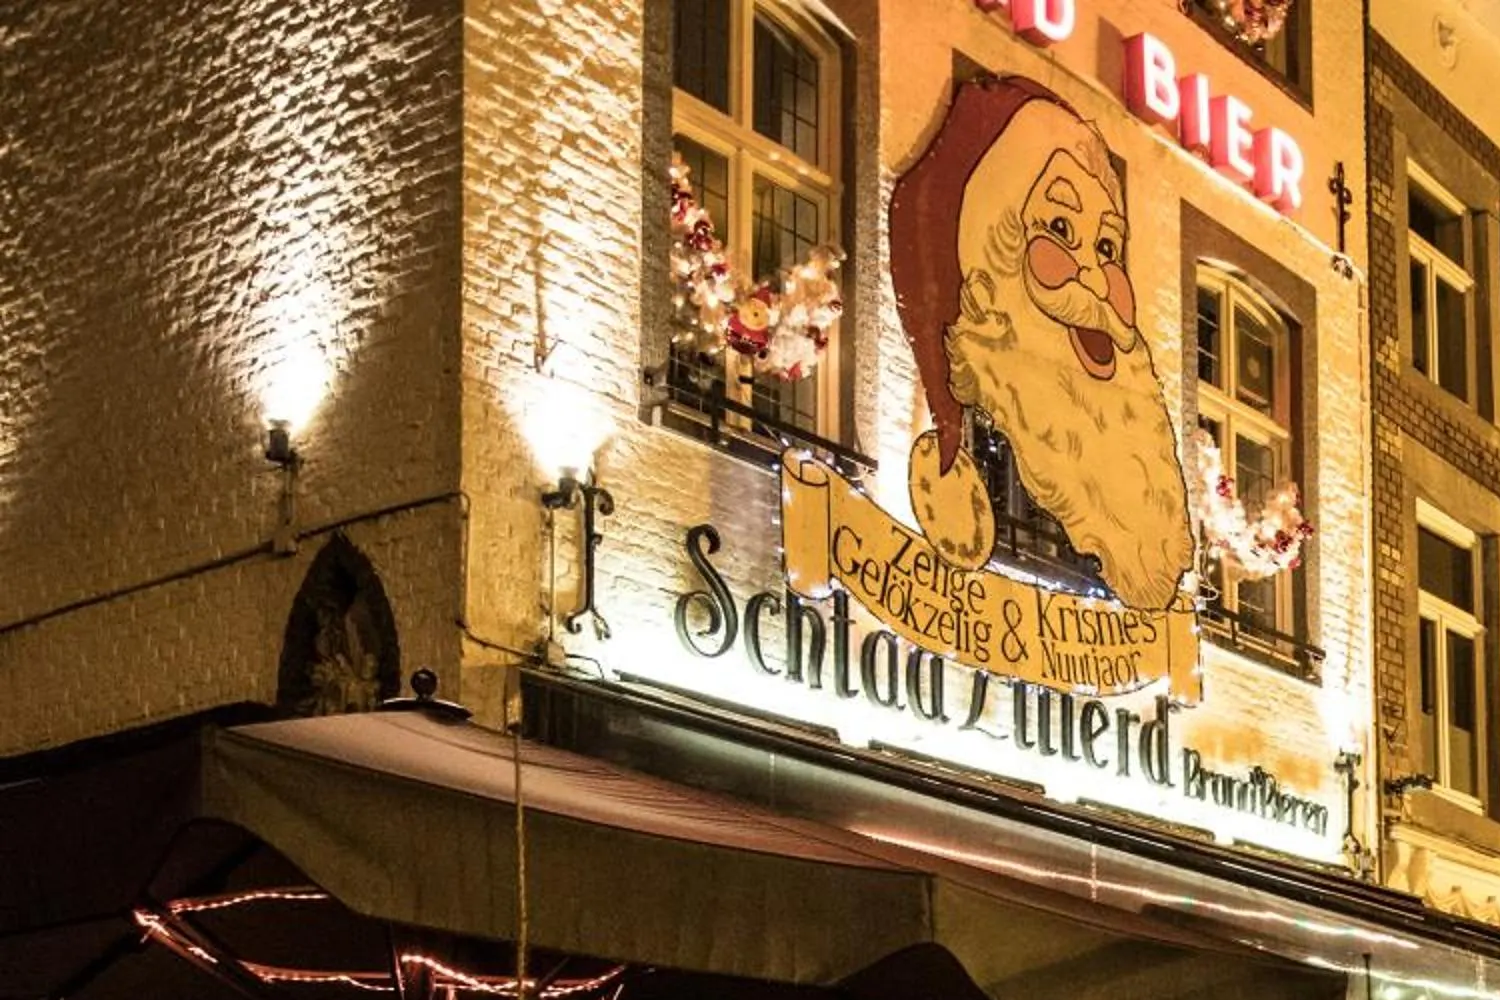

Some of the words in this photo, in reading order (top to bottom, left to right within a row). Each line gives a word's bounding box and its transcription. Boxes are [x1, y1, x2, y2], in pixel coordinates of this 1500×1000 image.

[1130, 32, 1304, 211] BIER
[833, 525, 993, 663] Gelökzelig
[1001, 599, 1029, 663] &
[1036, 587, 1158, 646] Krismes
